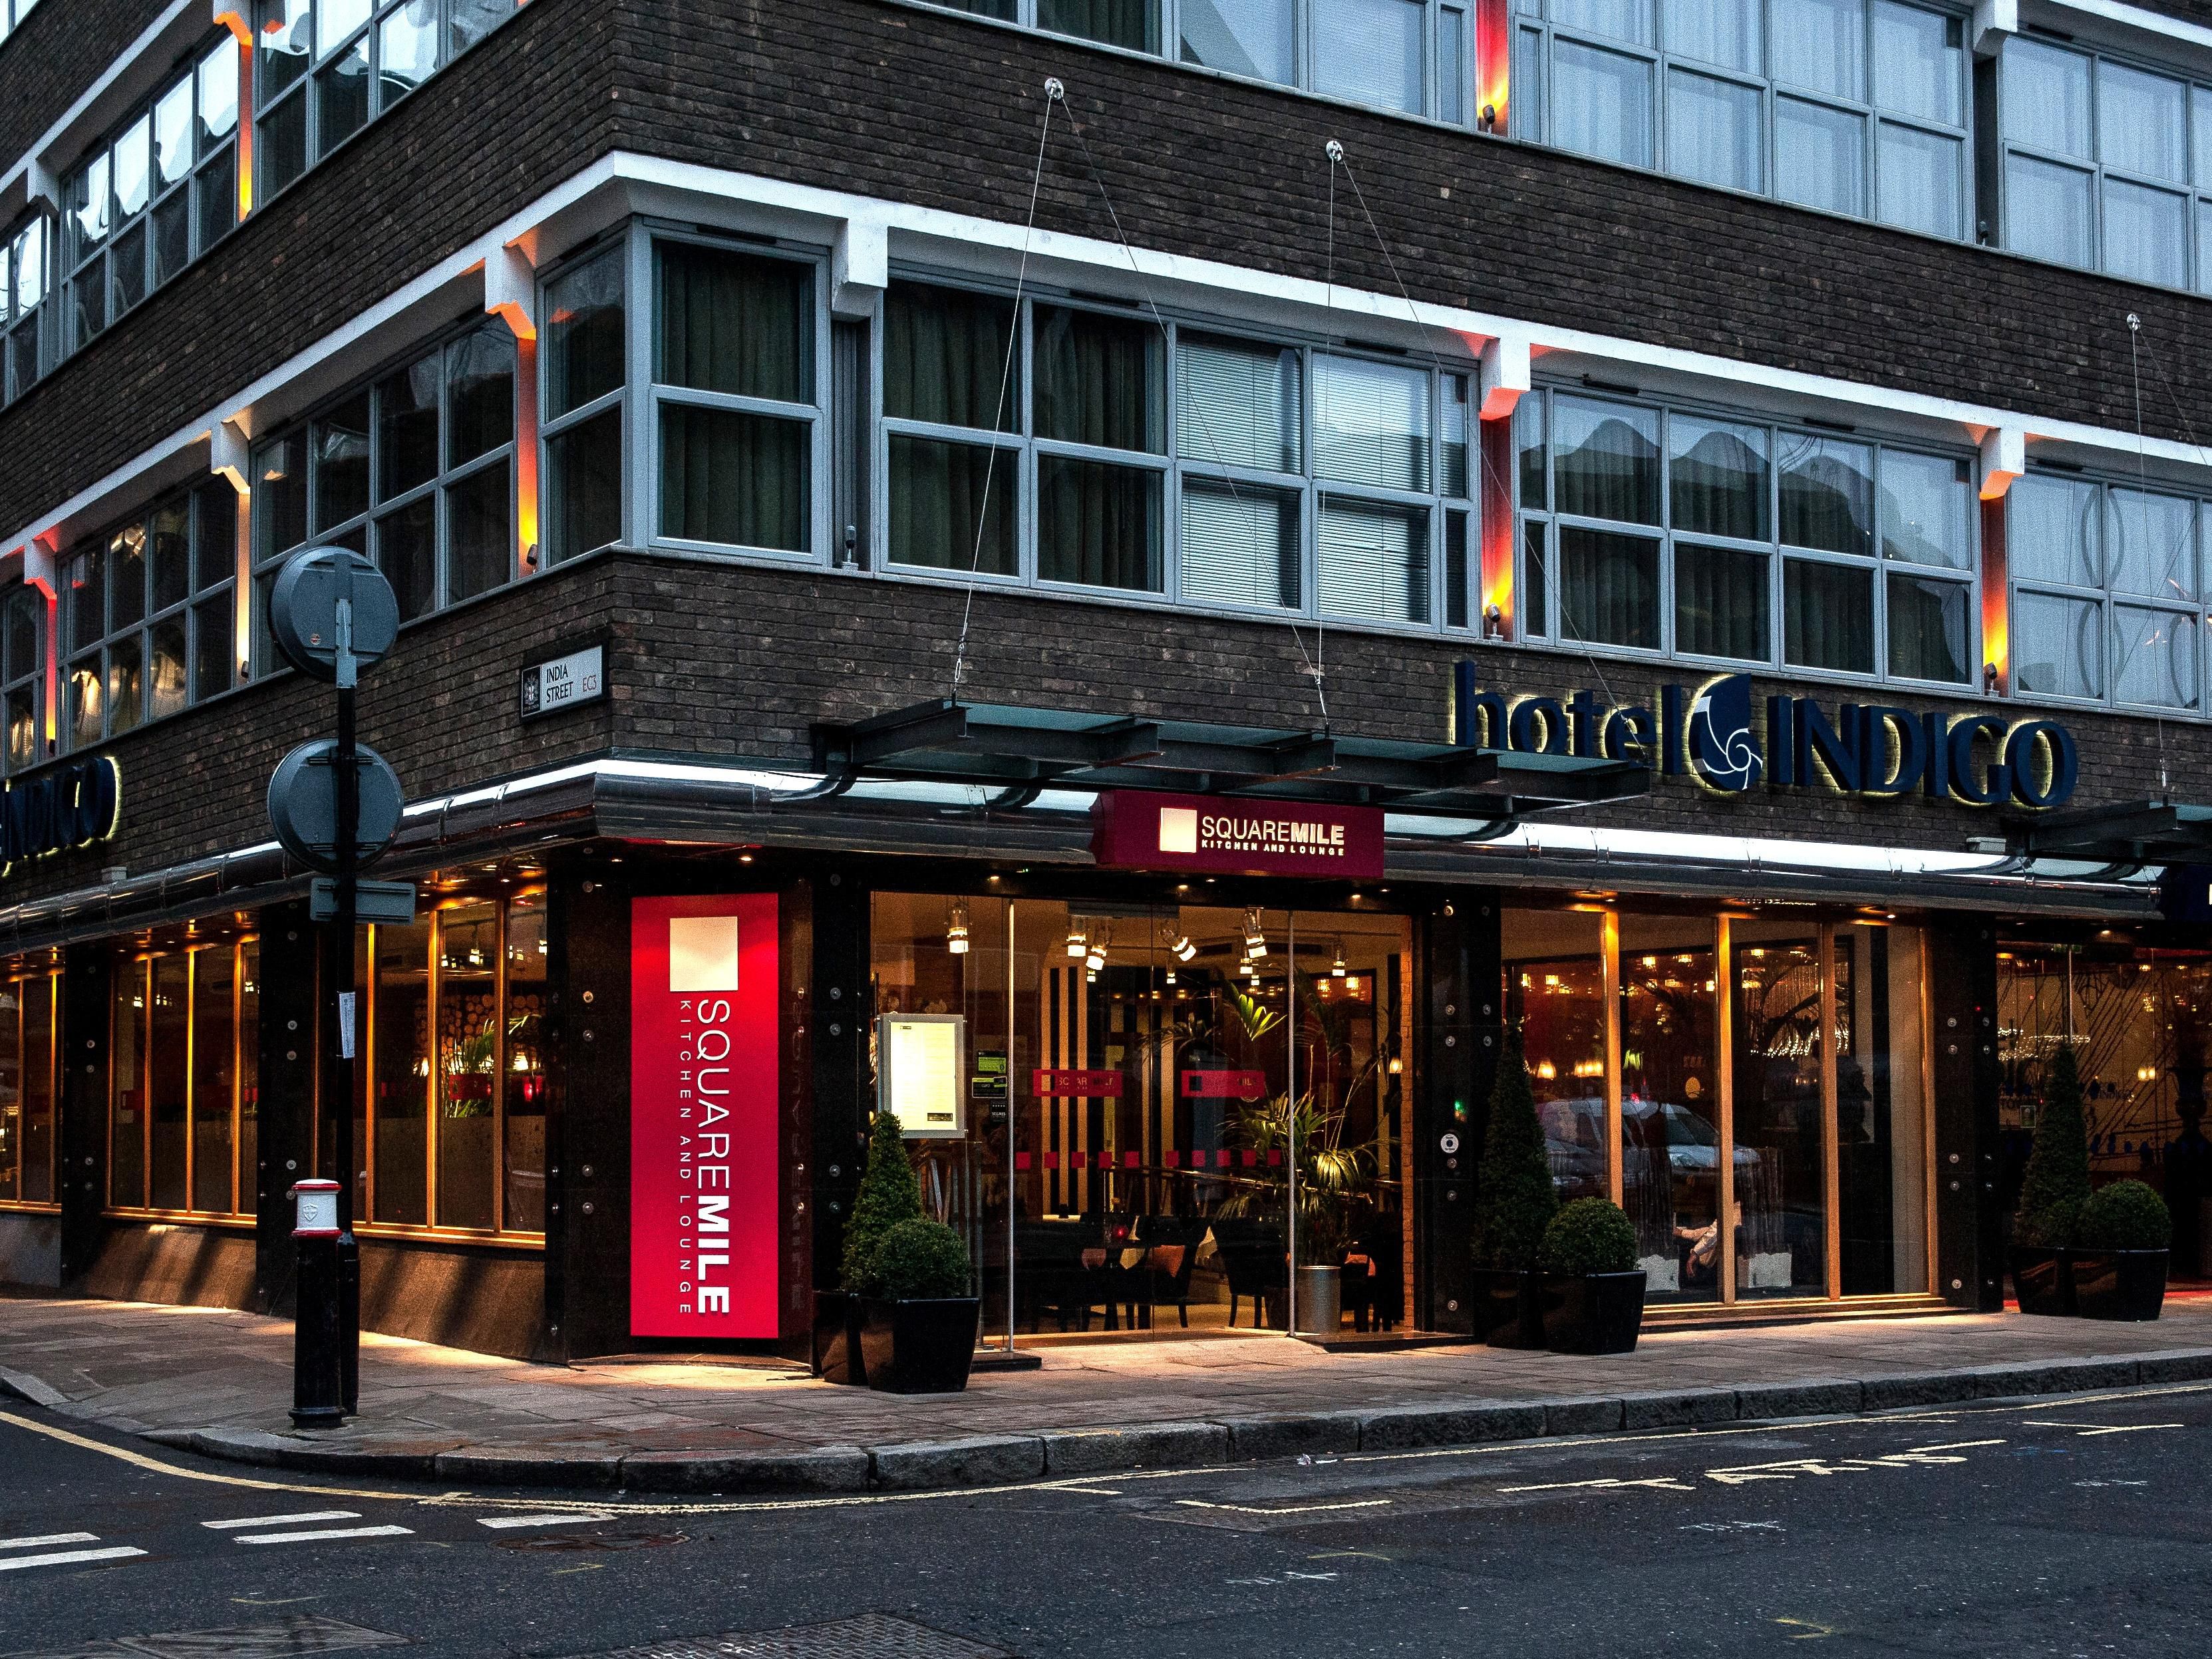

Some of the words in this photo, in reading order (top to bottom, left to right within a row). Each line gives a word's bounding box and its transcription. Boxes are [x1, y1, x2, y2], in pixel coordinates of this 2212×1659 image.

[546, 663, 568, 683] INDIA
[583, 674, 597, 692] EC3
[546, 681, 573, 703] STREET
[1455, 659, 1682, 776] hotel
[1768, 695, 2079, 808] INDIGO
[1201, 839, 1257, 851] KITCHEN
[1264, 843, 1285, 853] AND
[1290, 845, 1344, 856] LOUNGE
[680, 1000, 691, 1118] KITCHEN
[680, 1135, 691, 1179] AND
[680, 1195, 691, 1313] LOUNGE
[1591, 1453, 1967, 1490] TAXIS
